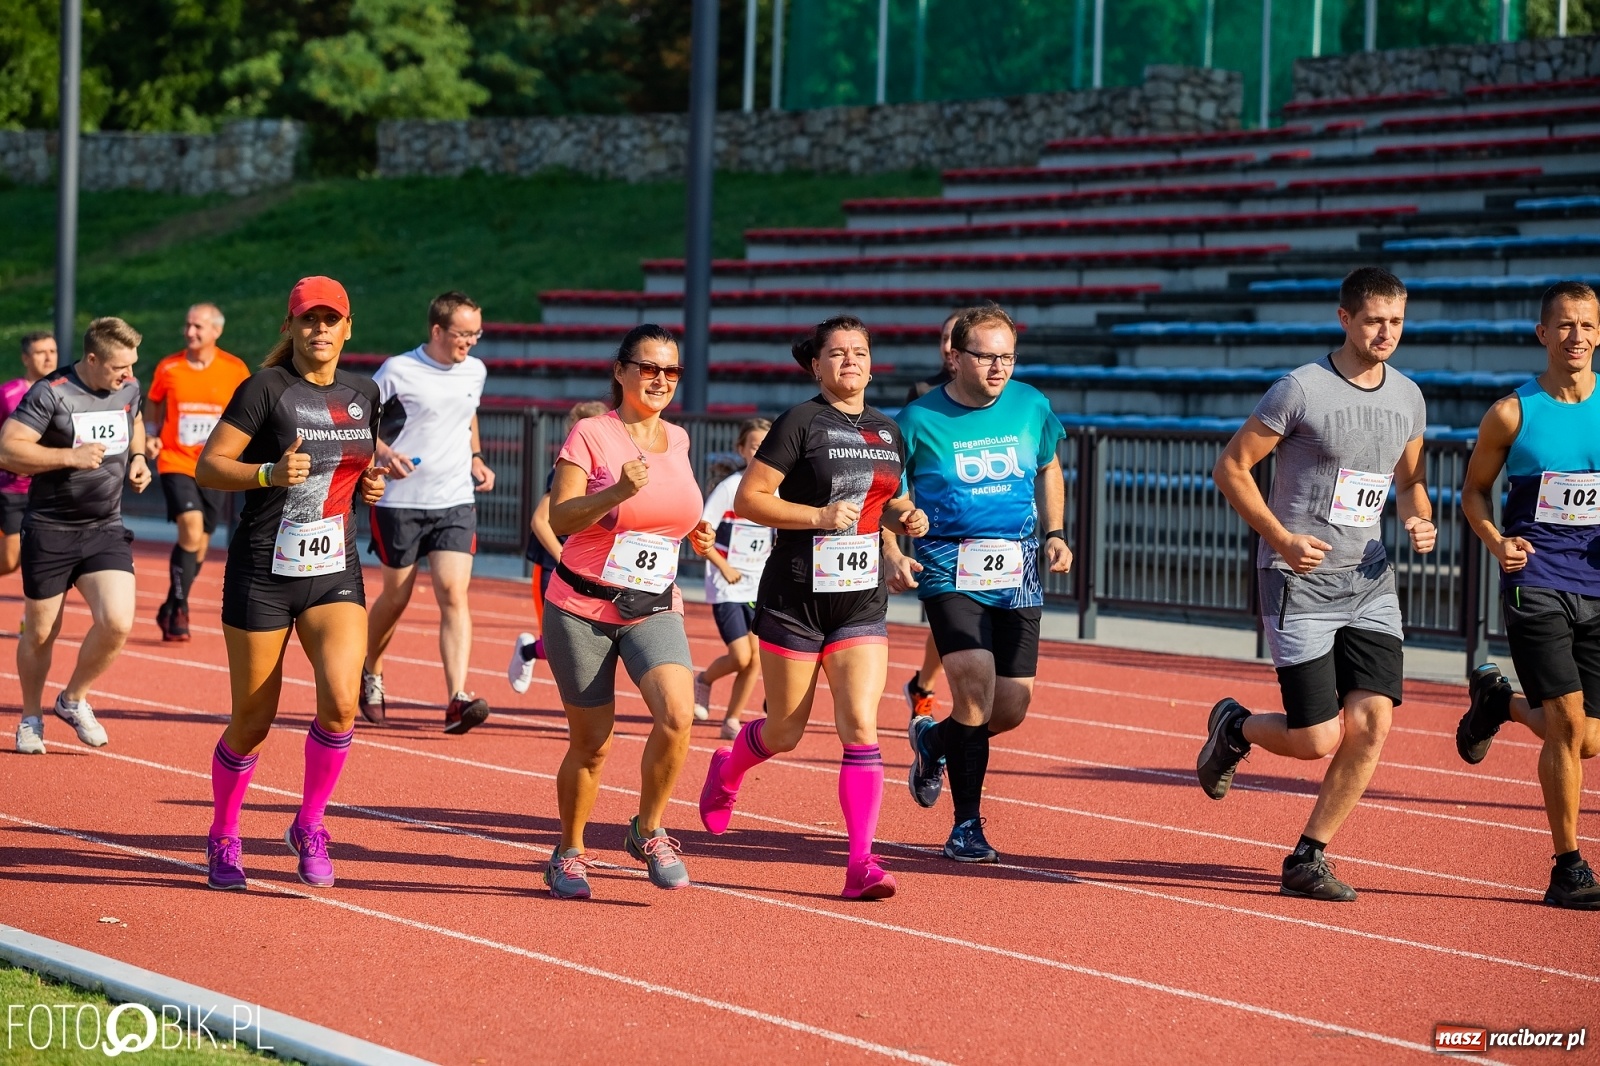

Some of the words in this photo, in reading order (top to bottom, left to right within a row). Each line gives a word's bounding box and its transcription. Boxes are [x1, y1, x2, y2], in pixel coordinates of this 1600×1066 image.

[91, 424, 115, 440] 125
[296, 427, 372, 441] RUNMAGEDDON
[1322, 405, 1409, 448] ARLINGTON
[954, 446, 1025, 484] bbl
[971, 483, 1012, 496] RACIBÓRZ
[1357, 488, 1383, 508] 105
[1563, 488, 1597, 506] 102
[298, 535, 331, 557] 140
[635, 549, 658, 571] 83
[836, 551, 868, 571] 148
[983, 554, 1005, 572] 28
